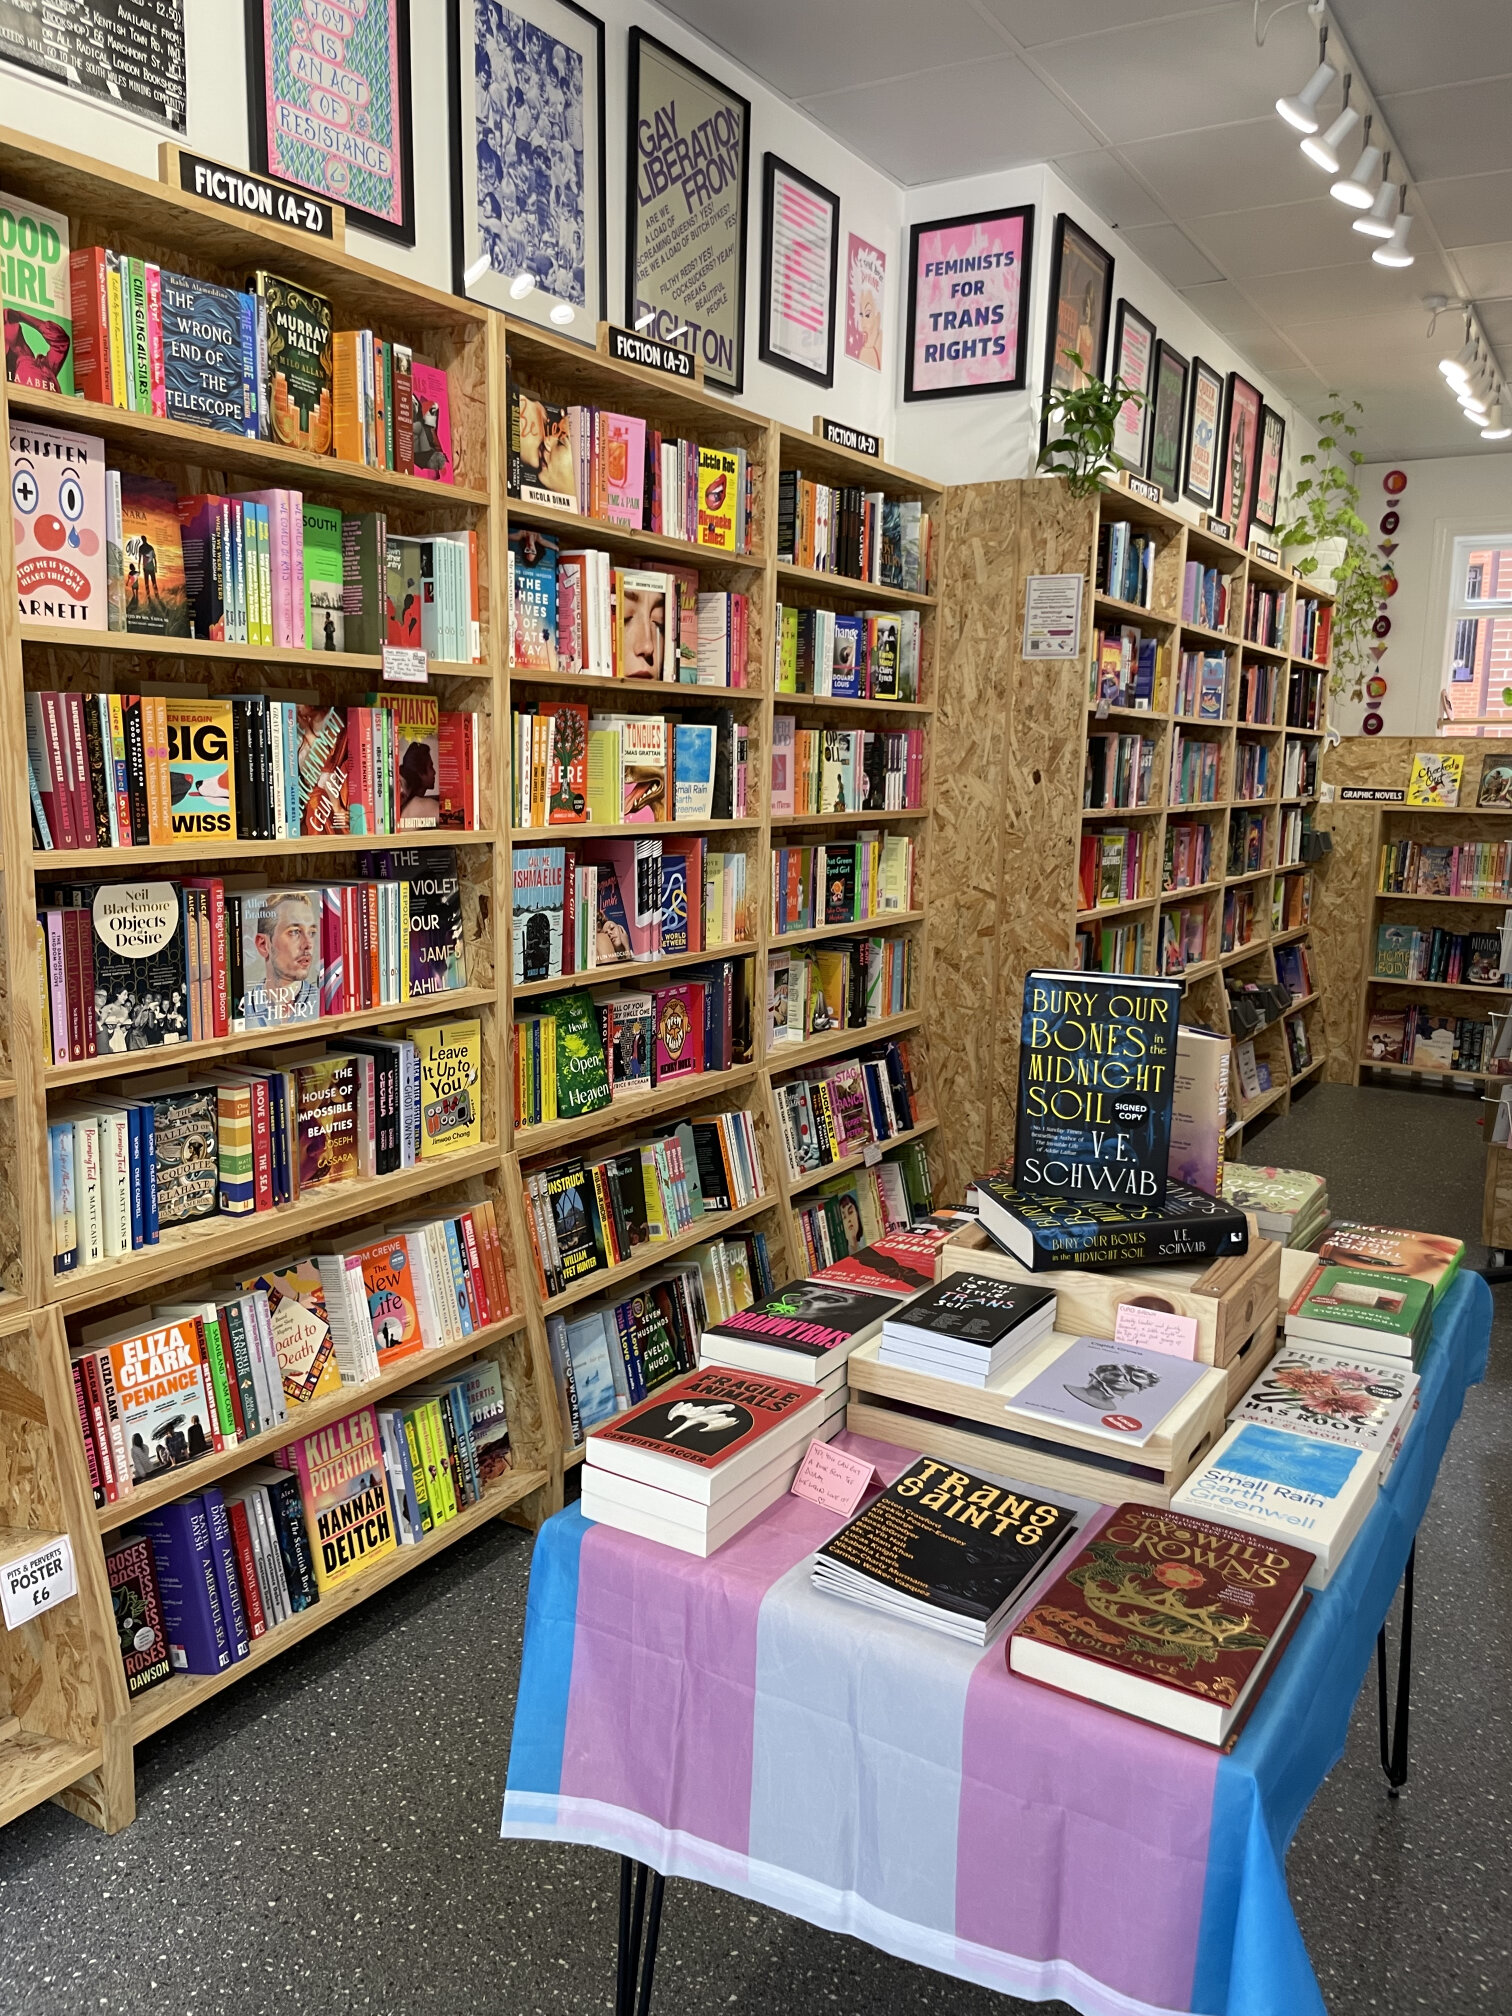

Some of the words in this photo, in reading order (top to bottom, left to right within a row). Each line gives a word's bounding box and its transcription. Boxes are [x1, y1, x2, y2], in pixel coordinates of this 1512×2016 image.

[93, 10, 127, 37] KENTISH
[129, 27, 148, 47] TOWN
[118, 4, 158, 34] AVAILABLE
[311, 4, 346, 31] JOY
[76, 40, 110, 66] RADICAL
[112, 54, 141, 77] LONDON
[320, 34, 338, 60] IS
[297, 55, 325, 83] AN
[331, 66, 364, 99] ACT
[319, 93, 342, 118] OF
[280, 105, 389, 174] RESISTANCE
[638, 100, 679, 159] GAY
[637, 105, 741, 208] LIBERATION
[681, 141, 740, 215] FRONT
[194, 165, 273, 217] FICTION
[277, 193, 323, 232] (A-Z)
[637, 235, 671, 268] SCREAMING
[925, 251, 1015, 278] FEMINISTS
[166, 289, 195, 310] THE
[695, 282, 725, 312] BEAUTIFUL
[951, 280, 985, 299] FOR
[706, 293, 729, 318] PEOPLE
[177, 316, 232, 345] WRONG
[276, 311, 328, 344] MURRAY
[929, 305, 1005, 332] TRANS
[288, 332, 320, 356] HALL
[637, 300, 702, 352] RIGHT
[702, 324, 733, 372] ON
[171, 341, 201, 362] END
[205, 348, 224, 366] OF
[617, 335, 661, 367] FICTION
[663, 346, 690, 375] (A-Z)
[924, 336, 1006, 363] RIGHTS
[280, 356, 301, 368] MILO
[302, 364, 324, 379] ALLAN
[27, 377, 56, 392] ABER
[200, 372, 227, 393] THE
[165, 389, 242, 420] TELESCOPE
[828, 425, 857, 449] FICTION
[858, 434, 876, 454] (A-Z)
[698, 451, 721, 471] Little
[722, 457, 735, 473] Rot
[529, 490, 550, 504] NICOLA
[552, 492, 571, 506] DINAN
[302, 515, 337, 532] SOUTH
[518, 577, 541, 590] THE
[522, 618, 538, 628] OF
[181, 715, 213, 723] BEAGIN
[626, 723, 661, 748] TONGUES
[309, 795, 334, 832] CELIA
[325, 766, 348, 799] BELL
[693, 784, 708, 794] Rain
[1343, 790, 1373, 799] GRAPHIC
[1374, 790, 1403, 800] NOVELS
[390, 850, 420, 867] THE
[411, 878, 457, 896] VIOLET
[513, 868, 562, 888] ISHMAELLE
[103, 900, 170, 915] Blackmore
[125, 889, 150, 901] Neil
[109, 915, 166, 933] Objects
[116, 930, 162, 948] Desire
[247, 987, 298, 1006] HENRY
[1033, 988, 1098, 1016] BURY
[1108, 995, 1169, 1023] OUR
[267, 1001, 317, 1021] HENRY
[1031, 1017, 1146, 1058] BONES
[1150, 1044, 1167, 1055] the
[429, 1046, 468, 1061] Leave
[570, 1055, 601, 1075] Open
[334, 1067, 353, 1079] THE
[436, 1063, 456, 1079] Up
[458, 1059, 470, 1073] to
[835, 1068, 857, 1083] STAG
[1028, 1054, 1165, 1093] MIDNIGHT
[302, 1088, 337, 1103] HOUSE
[430, 1076, 461, 1099] You
[569, 1083, 609, 1107] Heaven
[1217, 1053, 1230, 1116] MARSHA
[175, 1107, 193, 1118] THE
[820, 1086, 829, 1113] DUCK
[825, 1114, 836, 1140] FEET
[1026, 1086, 1111, 1125] SOIL
[1114, 1103, 1147, 1113] SIGNED
[1119, 1112, 1143, 1121] COPY
[156, 1124, 199, 1142] BALLAD
[307, 1119, 353, 1138] BEAUTIES
[452, 1130, 471, 1142] Chong
[324, 1136, 353, 1150] JOSEPH
[317, 1153, 353, 1168] CASSARA
[1023, 1158, 1157, 1197] SCHWAB
[1334, 1230, 1401, 1246] SEXISM
[1341, 1222, 1376, 1232] BATES
[372, 1241, 400, 1258] CREWE
[1052, 1238, 1082, 1250] BURY
[1083, 1237, 1108, 1248] OUR
[1120, 1248, 1145, 1260] SOIL
[1158, 1241, 1206, 1256] SCHWAB
[563, 1249, 588, 1266] WILLIAM
[367, 1294, 402, 1319] Life
[940, 1291, 1015, 1310] TRANS
[637, 1317, 669, 1338] HUSBANDS
[641, 1308, 661, 1324] SEVEN
[1357, 1315, 1401, 1328] STRONG
[718, 1311, 853, 1350] BRAINWYRMS
[122, 1327, 185, 1365] ELIZA
[643, 1340, 670, 1361] EVELYN
[120, 1345, 193, 1388] CLARK
[648, 1354, 669, 1371] HUGO
[1286, 1351, 1329, 1365] THE
[1336, 1361, 1406, 1380] RIVER
[121, 1369, 199, 1411] PENANCE
[564, 1349, 581, 1440] WOODWORKING
[682, 1384, 788, 1412] ANIMALS
[696, 1374, 801, 1404] FRAGILE
[1244, 1401, 1289, 1416] HAS
[1297, 1414, 1378, 1438] ROOTS
[304, 1410, 374, 1468] KILLER
[603, 1432, 662, 1450] GENEVIEVE
[663, 1446, 707, 1463] JAGGER
[310, 1443, 378, 1497] POTENTIAL
[1196, 1477, 1266, 1504] Garth
[1204, 1470, 1269, 1492] Small
[1273, 1488, 1325, 1510] Rain
[317, 1486, 385, 1541] HANNAH
[1189, 1487, 1317, 1530] Greenwell
[322, 1509, 390, 1575] DEITCH
[1196, 1531, 1291, 1571] WILD
[7, 1568, 21, 1580] PITS
[30, 1547, 62, 1569] PERVERTS
[107, 1543, 147, 1573] ROSES
[293, 1540, 306, 1576] Scottish
[301, 1576, 310, 1594] Boy
[1105, 1526, 1282, 1589] CROWNS
[10, 1558, 63, 1594] POSTER
[32, 1587, 50, 1606] £6
[1069, 1633, 1121, 1658] HOLLY
[1131, 1654, 1181, 1676] RACE
[129, 1660, 170, 1691] DAWSON
